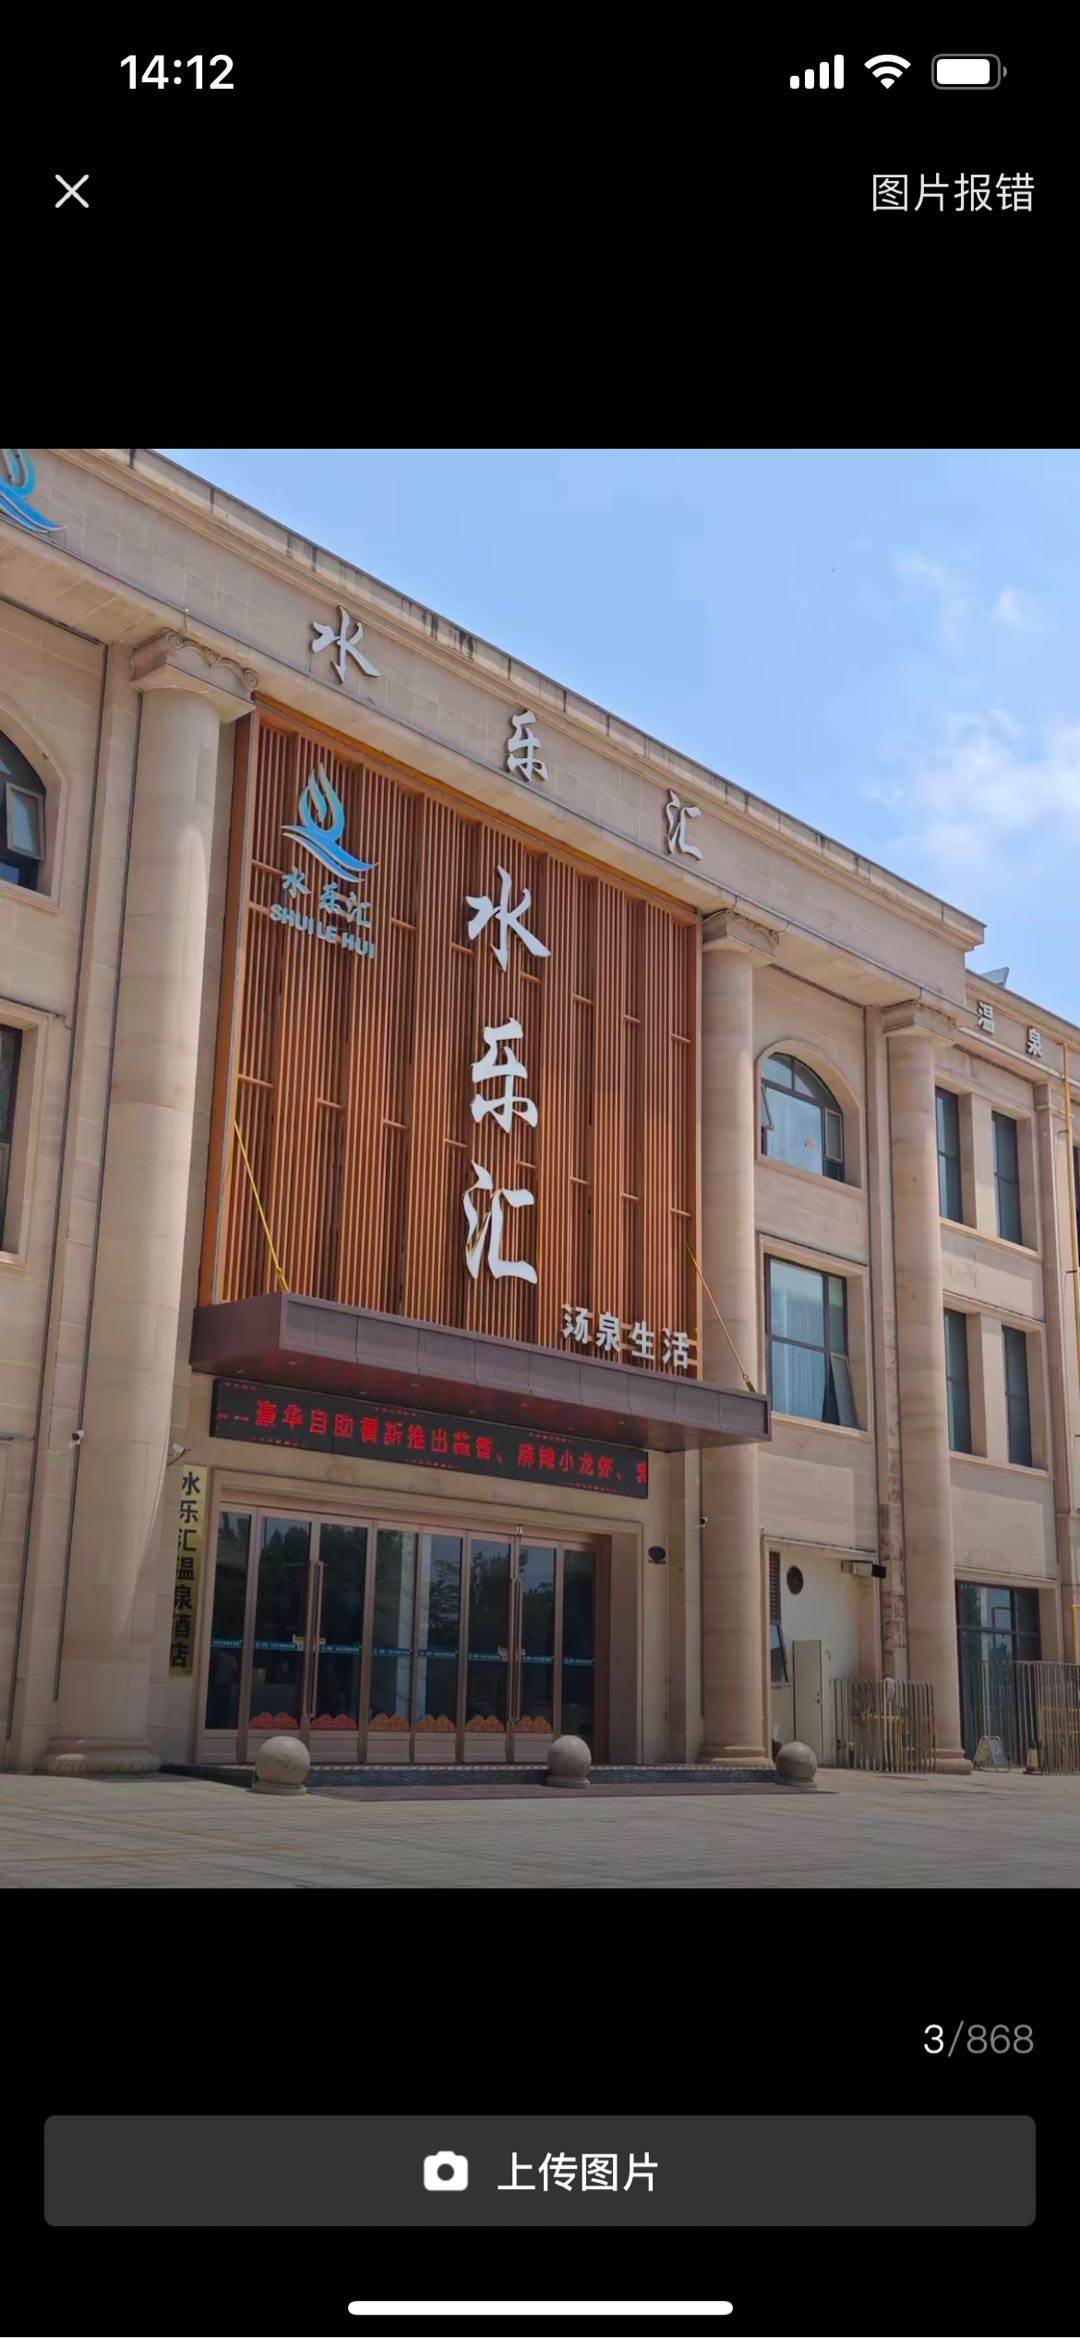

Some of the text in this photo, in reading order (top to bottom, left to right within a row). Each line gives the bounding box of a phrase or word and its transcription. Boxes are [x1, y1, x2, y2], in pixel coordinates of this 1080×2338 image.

[311, 605, 703, 862] 水乐汇
[282, 866, 373, 929] 水乐汇
[270, 903, 375, 960] SHUI LE HUI
[977, 1000, 1043, 1058] 温泉
[463, 864, 551, 1285] 水乐汇
[561, 1303, 690, 1370] 汤泉生活
[169, 1470, 201, 1670] 水乐汇温泉酒店
